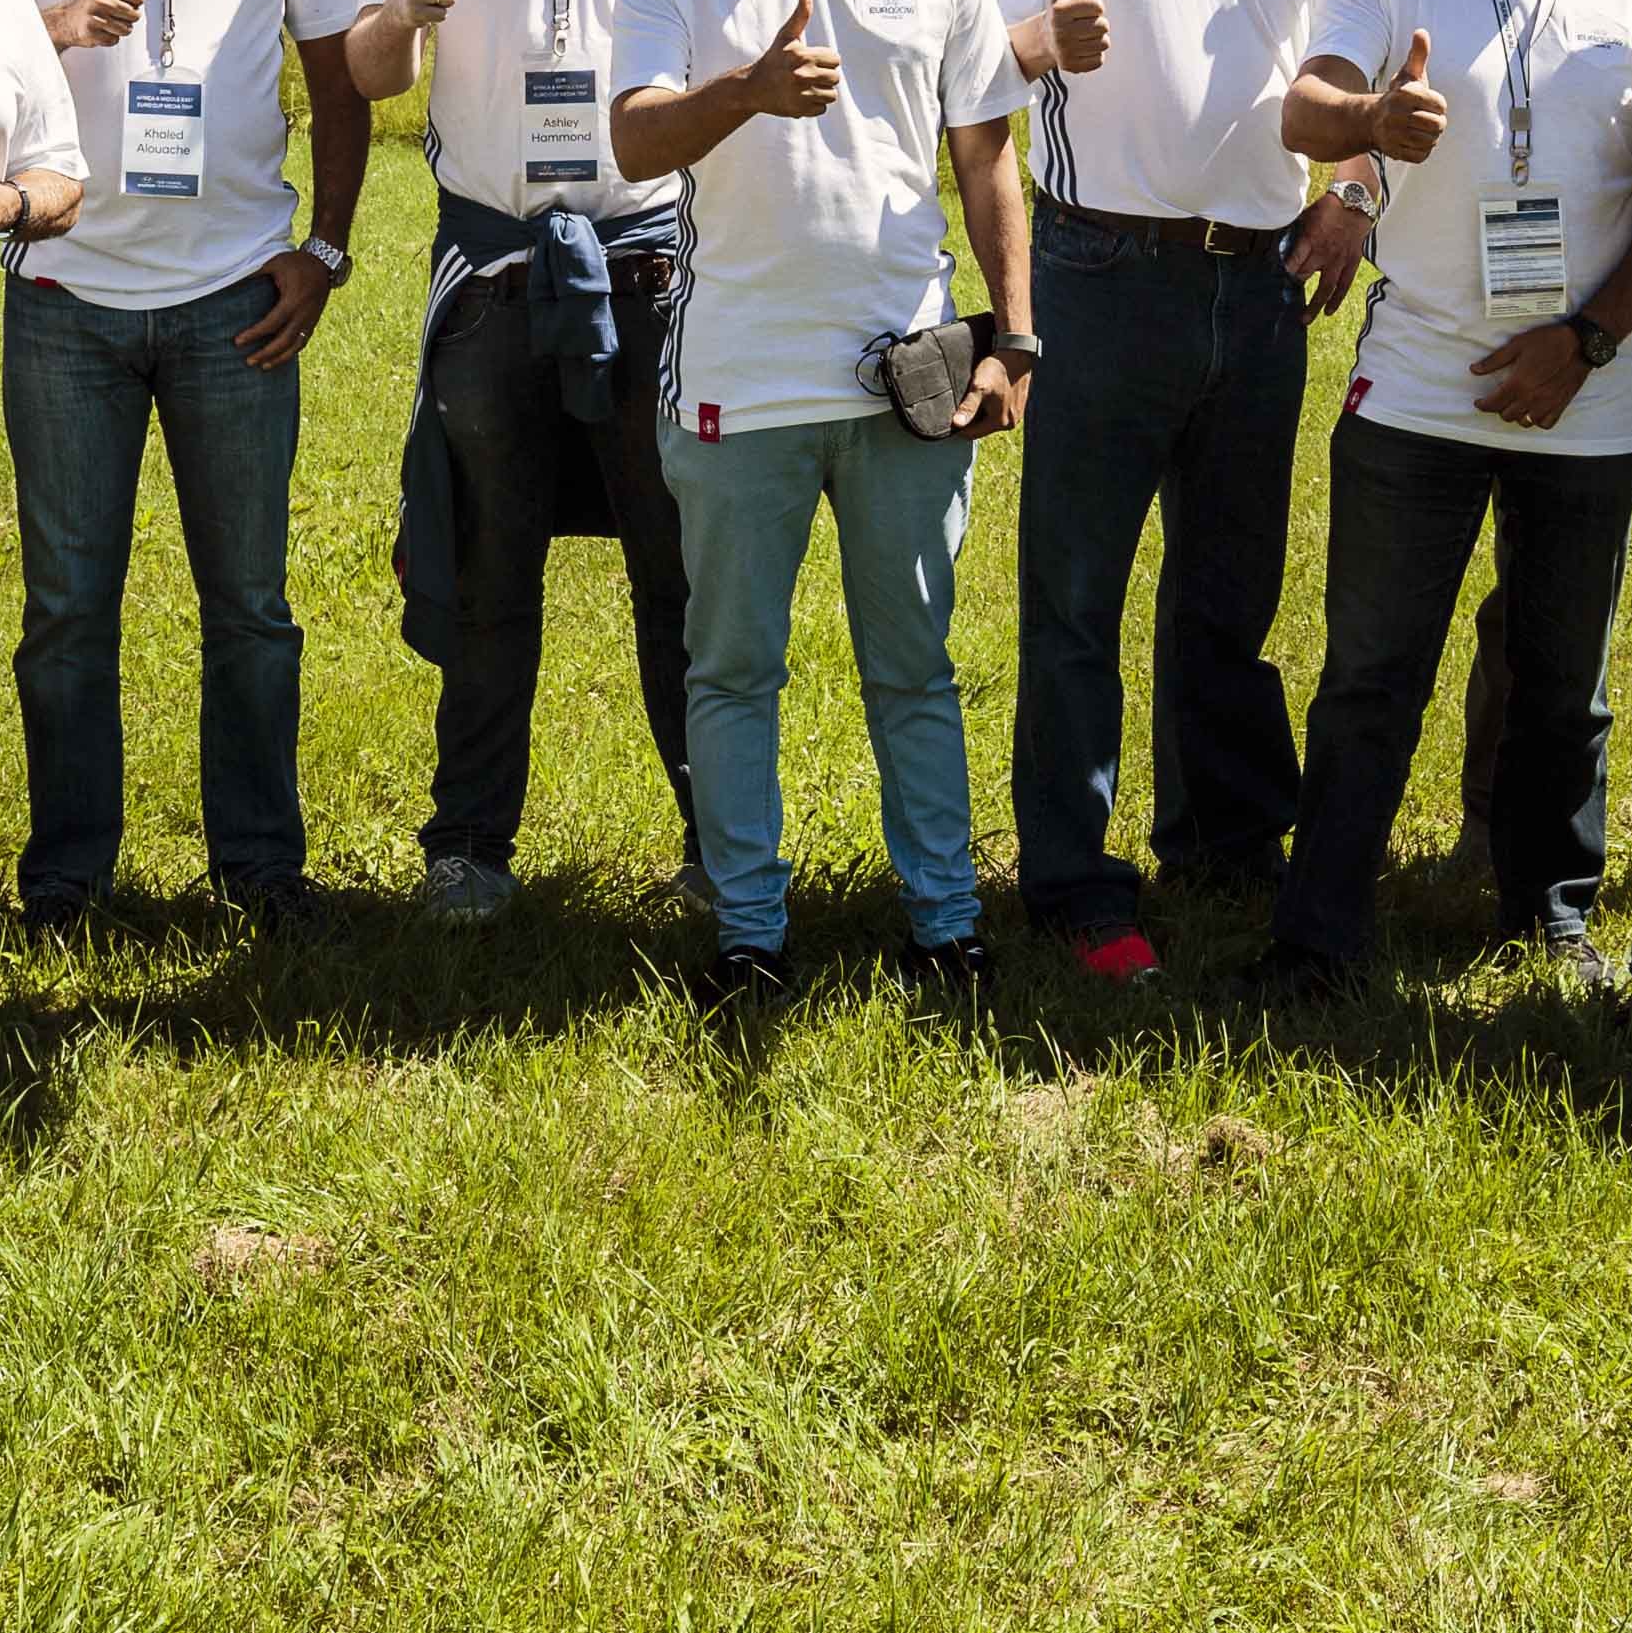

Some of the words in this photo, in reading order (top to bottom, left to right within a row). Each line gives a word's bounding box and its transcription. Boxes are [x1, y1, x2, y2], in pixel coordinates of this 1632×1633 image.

[543, 117, 579, 128] Ashley
[144, 128, 184, 140] Khaled
[531, 131, 592, 143] Hammond
[136, 143, 191, 155] Alouache
